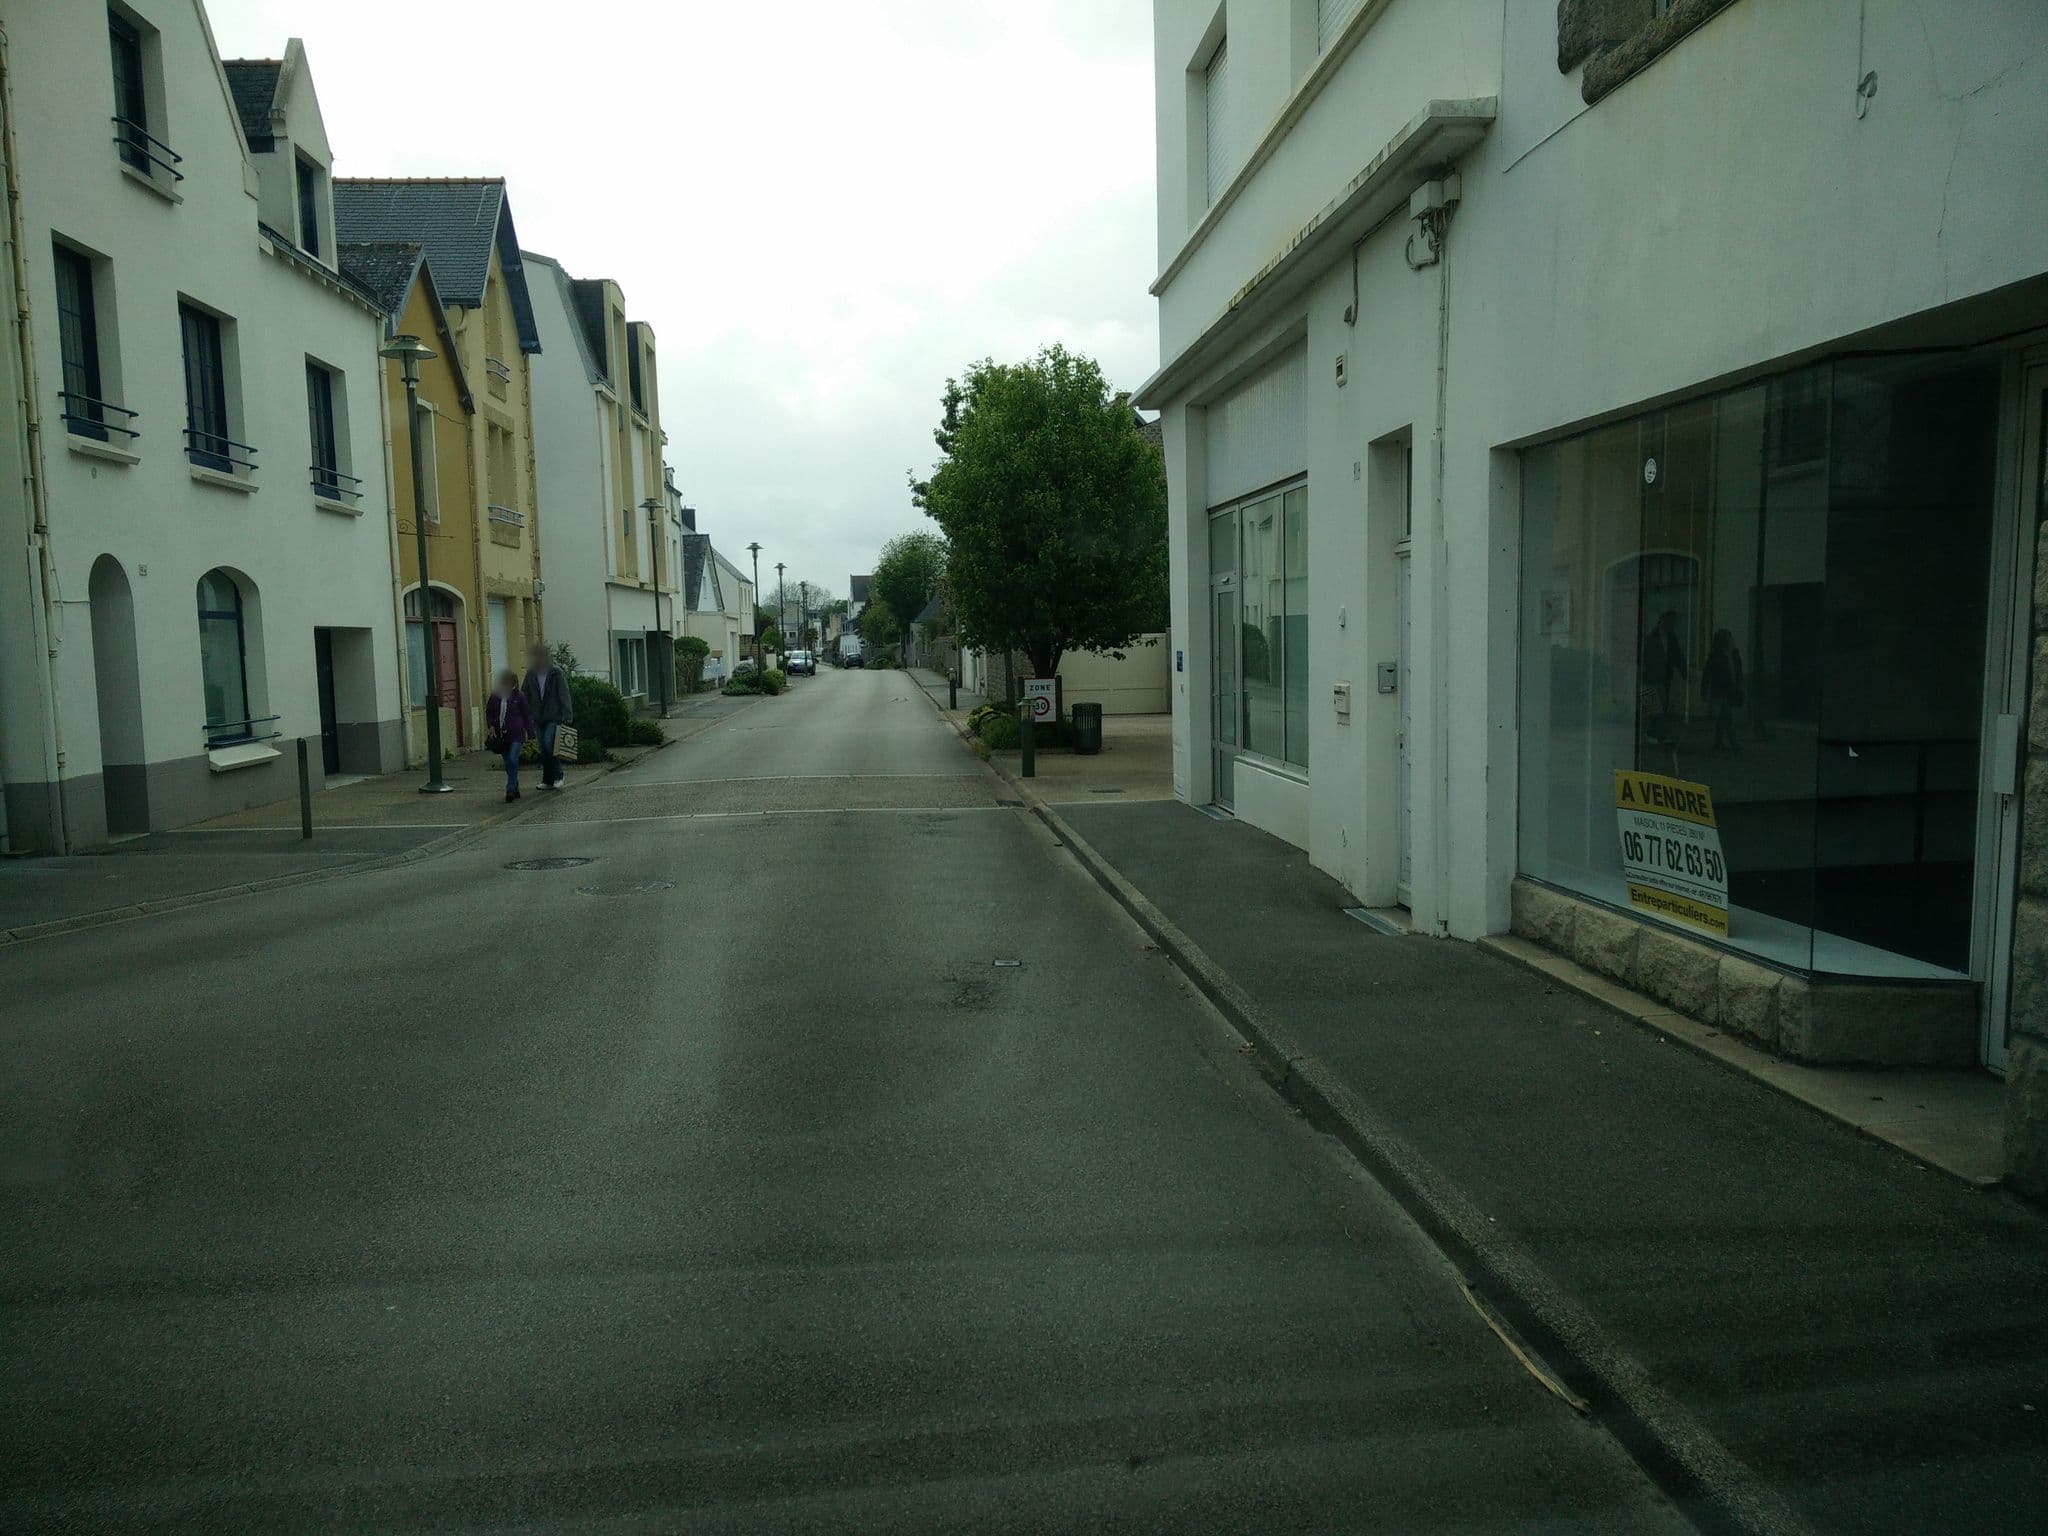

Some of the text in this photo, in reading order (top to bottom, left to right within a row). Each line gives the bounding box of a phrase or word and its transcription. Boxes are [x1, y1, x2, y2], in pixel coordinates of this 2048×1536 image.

[1034, 702, 1046, 710] 30
[1622, 779, 1710, 818] A VENDRE
[1624, 830, 1723, 884] 06 77 62 63 50
[1631, 888, 1726, 928] Entreparticuliers.com
